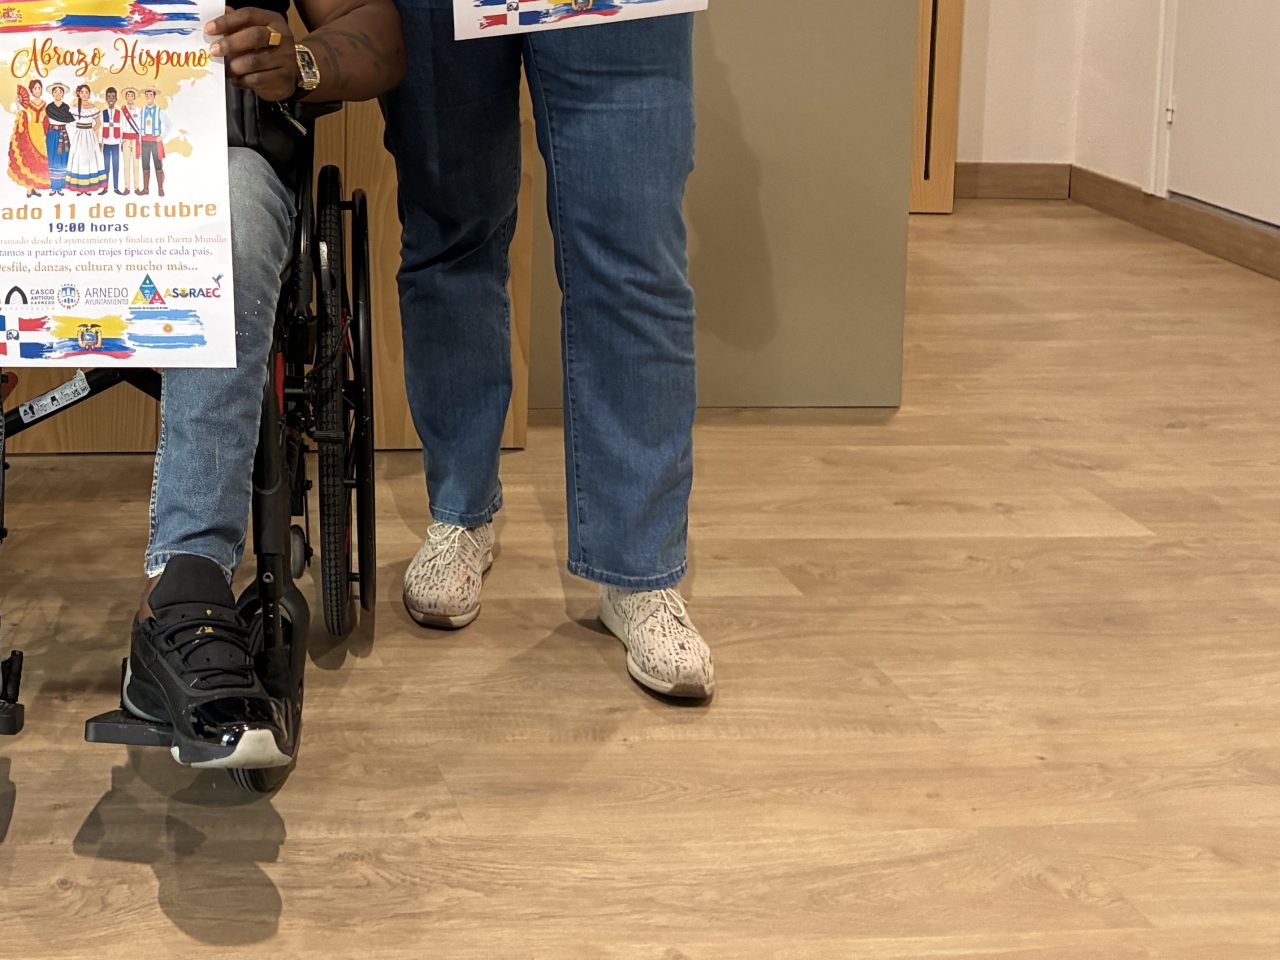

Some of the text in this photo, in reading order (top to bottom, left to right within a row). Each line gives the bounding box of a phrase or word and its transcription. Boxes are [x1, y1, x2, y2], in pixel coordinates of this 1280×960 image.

[11, 38, 104, 78] Abrazo
[110, 38, 211, 79] Hispano
[54, 204, 75, 219] 11
[89, 203, 114, 218] de
[126, 202, 216, 218] Octubre
[49, 223, 128, 232] 19:00 horas
[85, 288, 128, 298] ARNEDO
